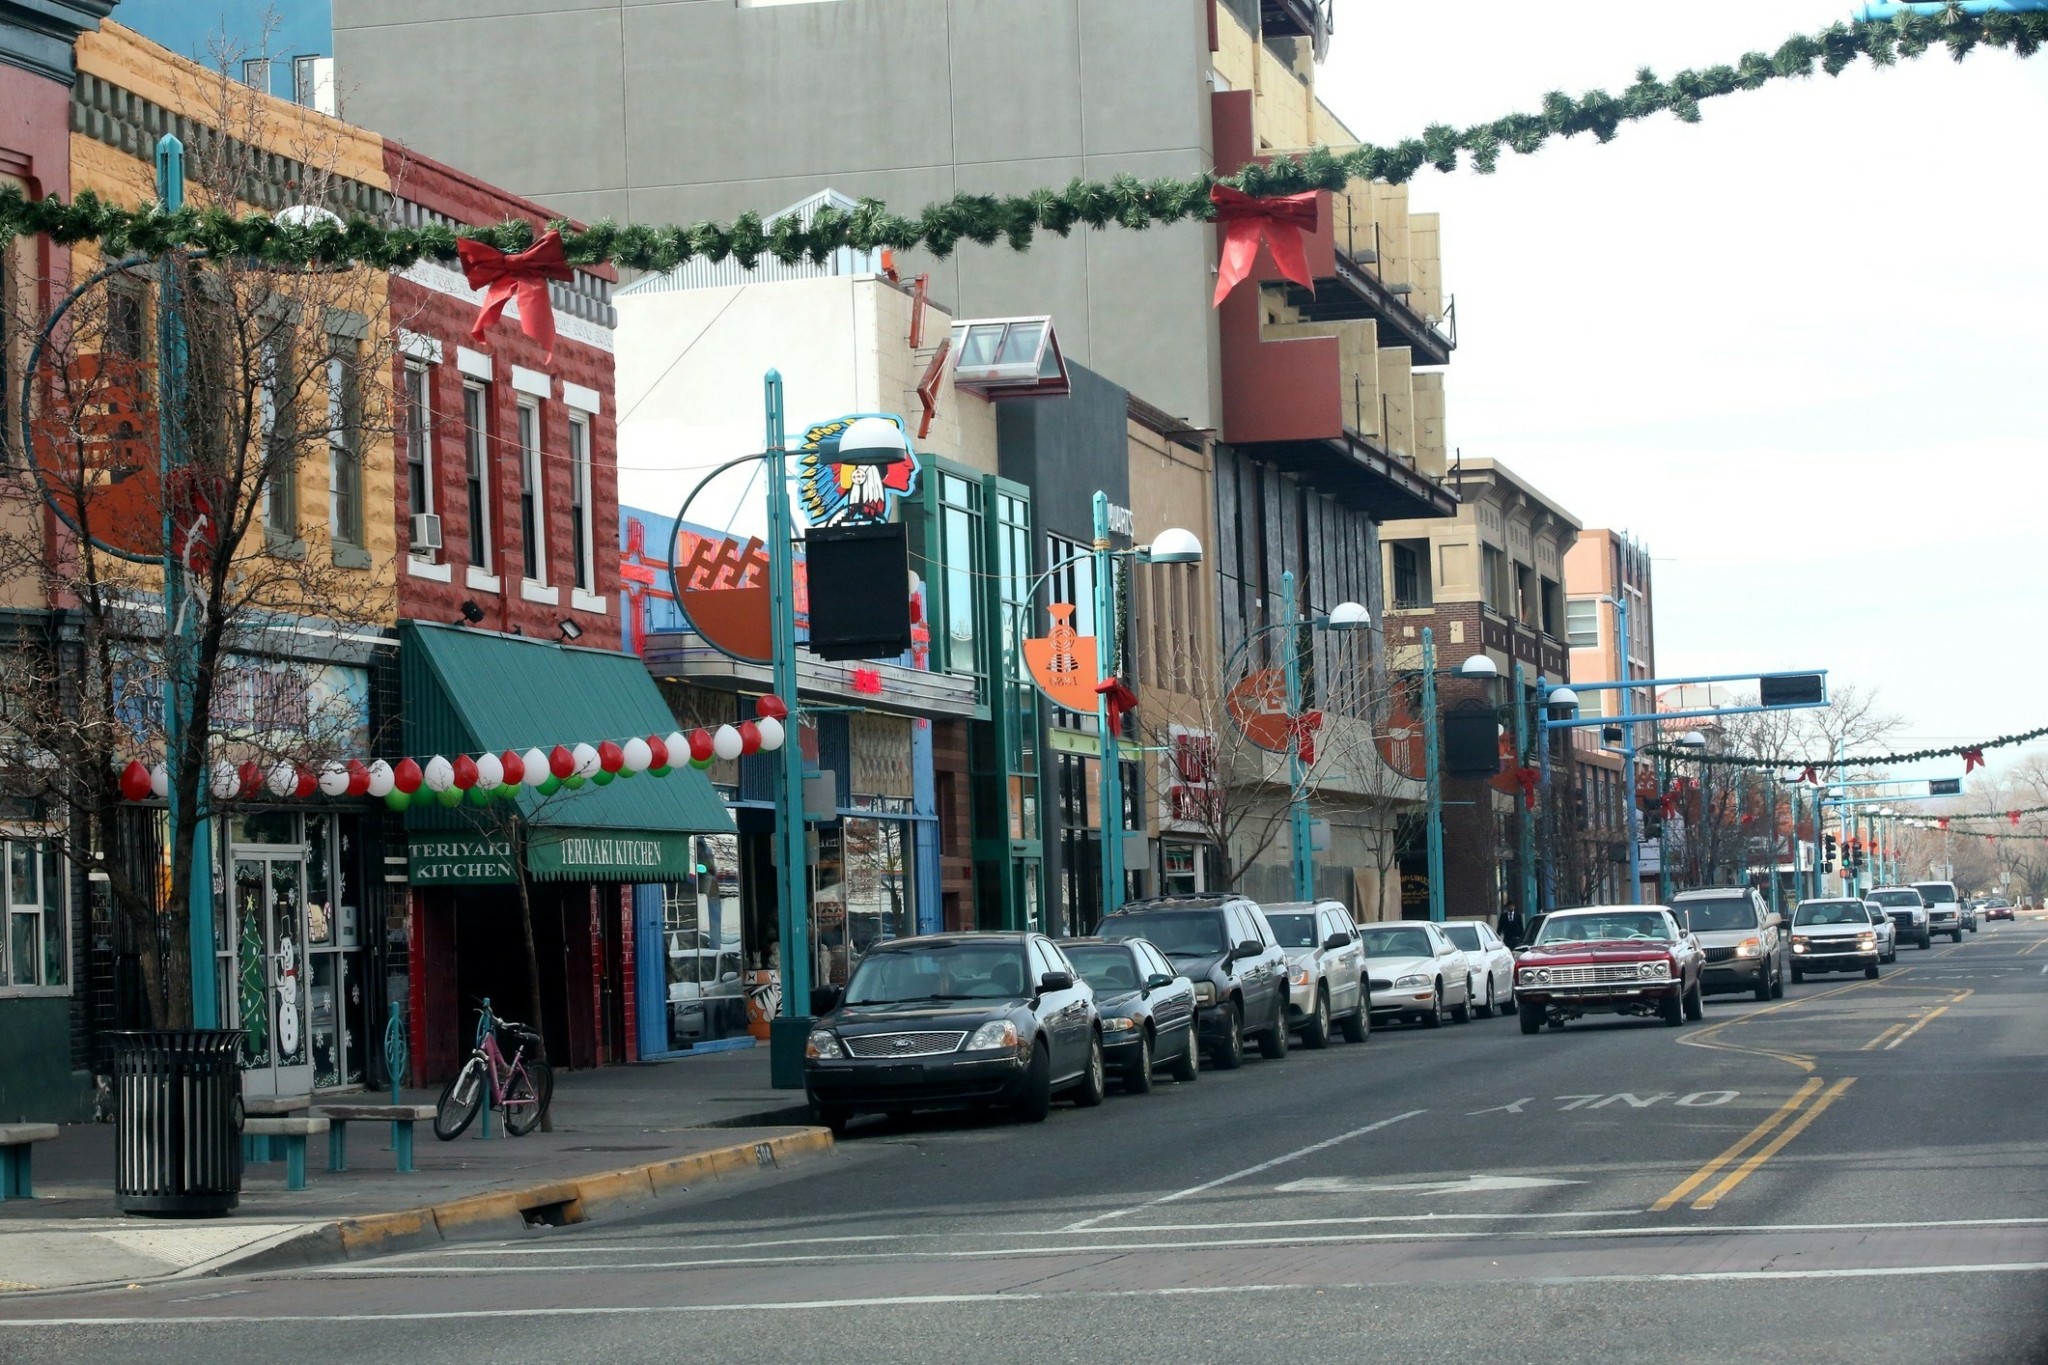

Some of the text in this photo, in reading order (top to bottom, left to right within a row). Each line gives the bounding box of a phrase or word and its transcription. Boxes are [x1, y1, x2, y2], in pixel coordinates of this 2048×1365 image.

[408, 842, 511, 858] TERIYAKI
[559, 838, 662, 866] TERIYAKI KITCHEN
[416, 863, 511, 879] KITCHEN
[1465, 1090, 1740, 1116] ONLY
